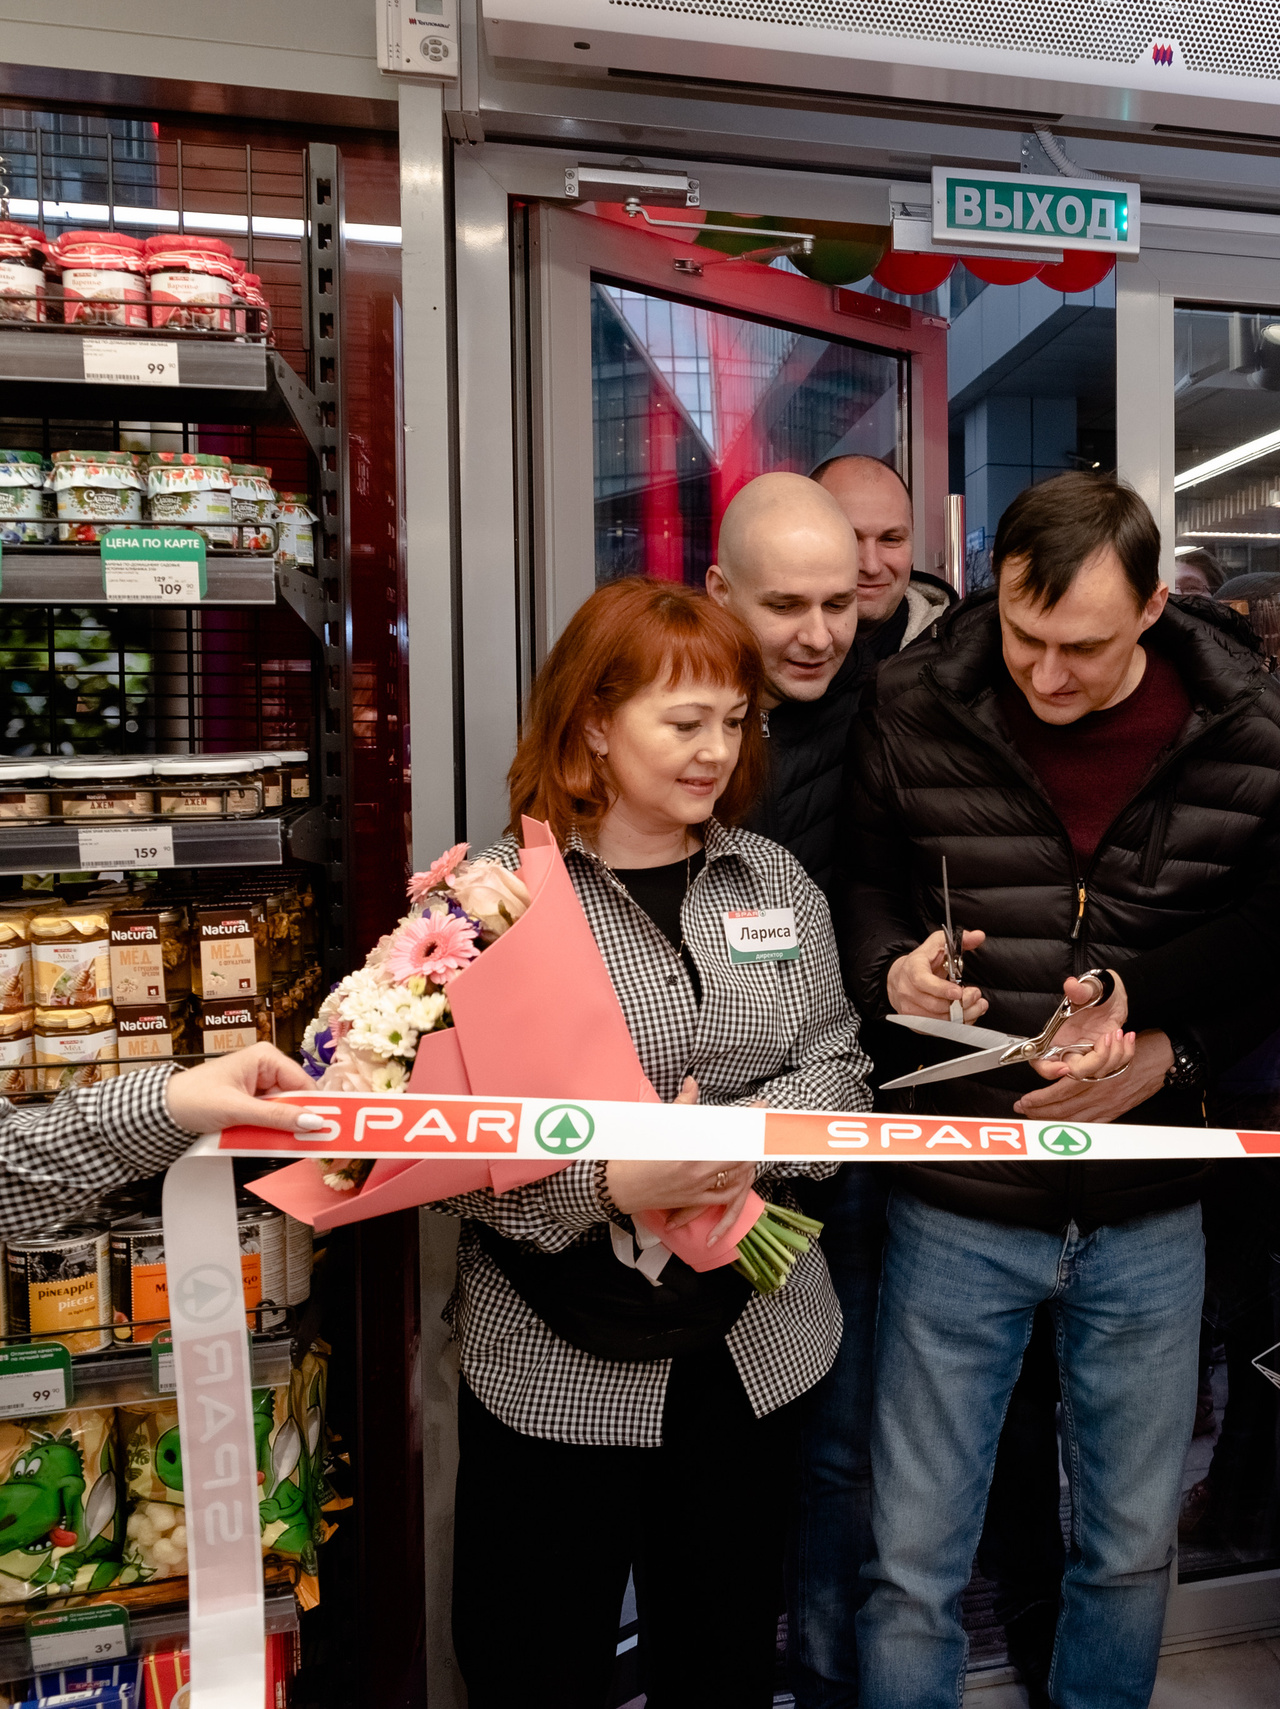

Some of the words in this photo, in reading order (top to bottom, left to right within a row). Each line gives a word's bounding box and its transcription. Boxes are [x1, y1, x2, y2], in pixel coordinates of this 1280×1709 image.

[955, 186, 1118, 241] ВЫХОД
[148, 363, 165, 374] 99
[106, 538, 140, 549] ЦЕНА
[142, 538, 161, 548] ПО
[164, 538, 200, 548] КАРТЕ
[158, 584, 182, 594] 109
[90, 801, 114, 810] ДЖЕМ
[134, 848, 158, 858] 159
[112, 929, 158, 940] Natural
[202, 922, 250, 936] Natural
[740, 926, 791, 942] Лариса
[120, 948, 152, 966] МЁД
[210, 942, 244, 960] МЁД
[120, 1018, 168, 1032] Natural
[206, 1012, 252, 1026] Natural
[128, 1038, 162, 1056] МЁД
[214, 1032, 246, 1050] МЁД
[294, 1106, 513, 1144] SPAR
[827, 1121, 1022, 1149] SPAR
[32, 1390, 50, 1402] 99
[95, 1643, 112, 1654] 39
